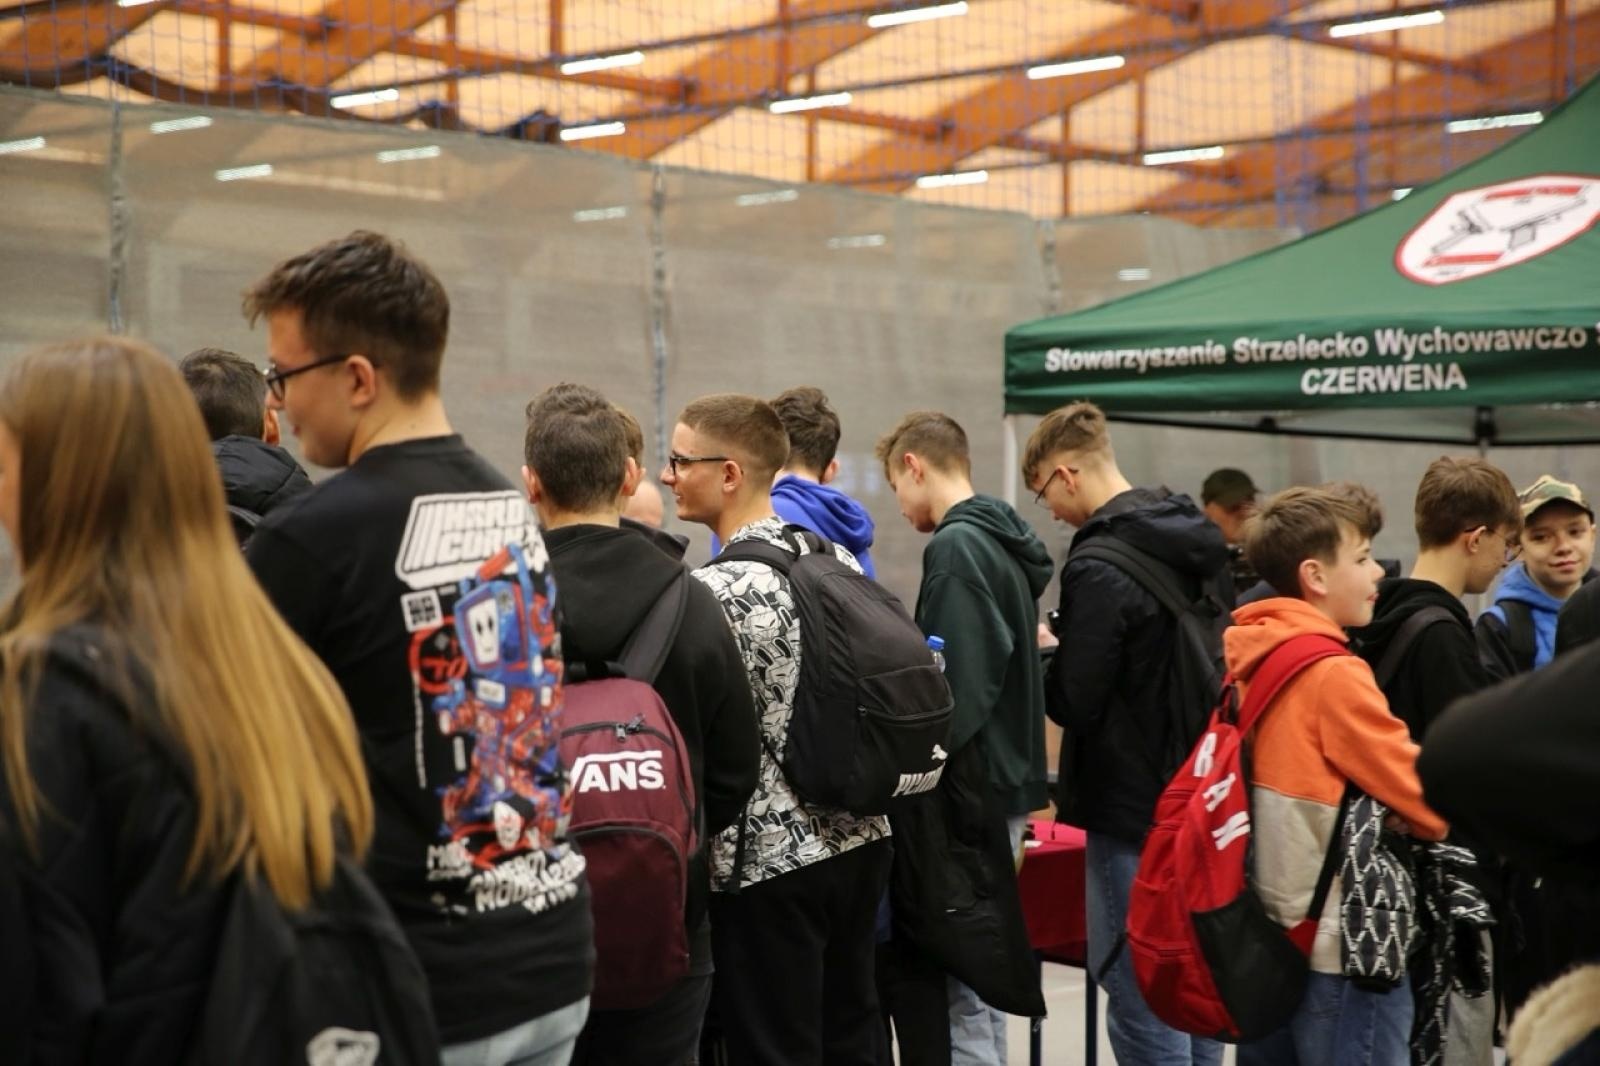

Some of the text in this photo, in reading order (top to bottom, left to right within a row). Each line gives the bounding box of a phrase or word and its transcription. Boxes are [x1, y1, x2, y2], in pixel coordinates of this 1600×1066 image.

[1044, 339, 1227, 374] Stowarzyszenie
[1232, 331, 1370, 364] Strzelecko
[1374, 325, 1588, 362] Wychowawczo
[1300, 362, 1468, 395] CZERWENA
